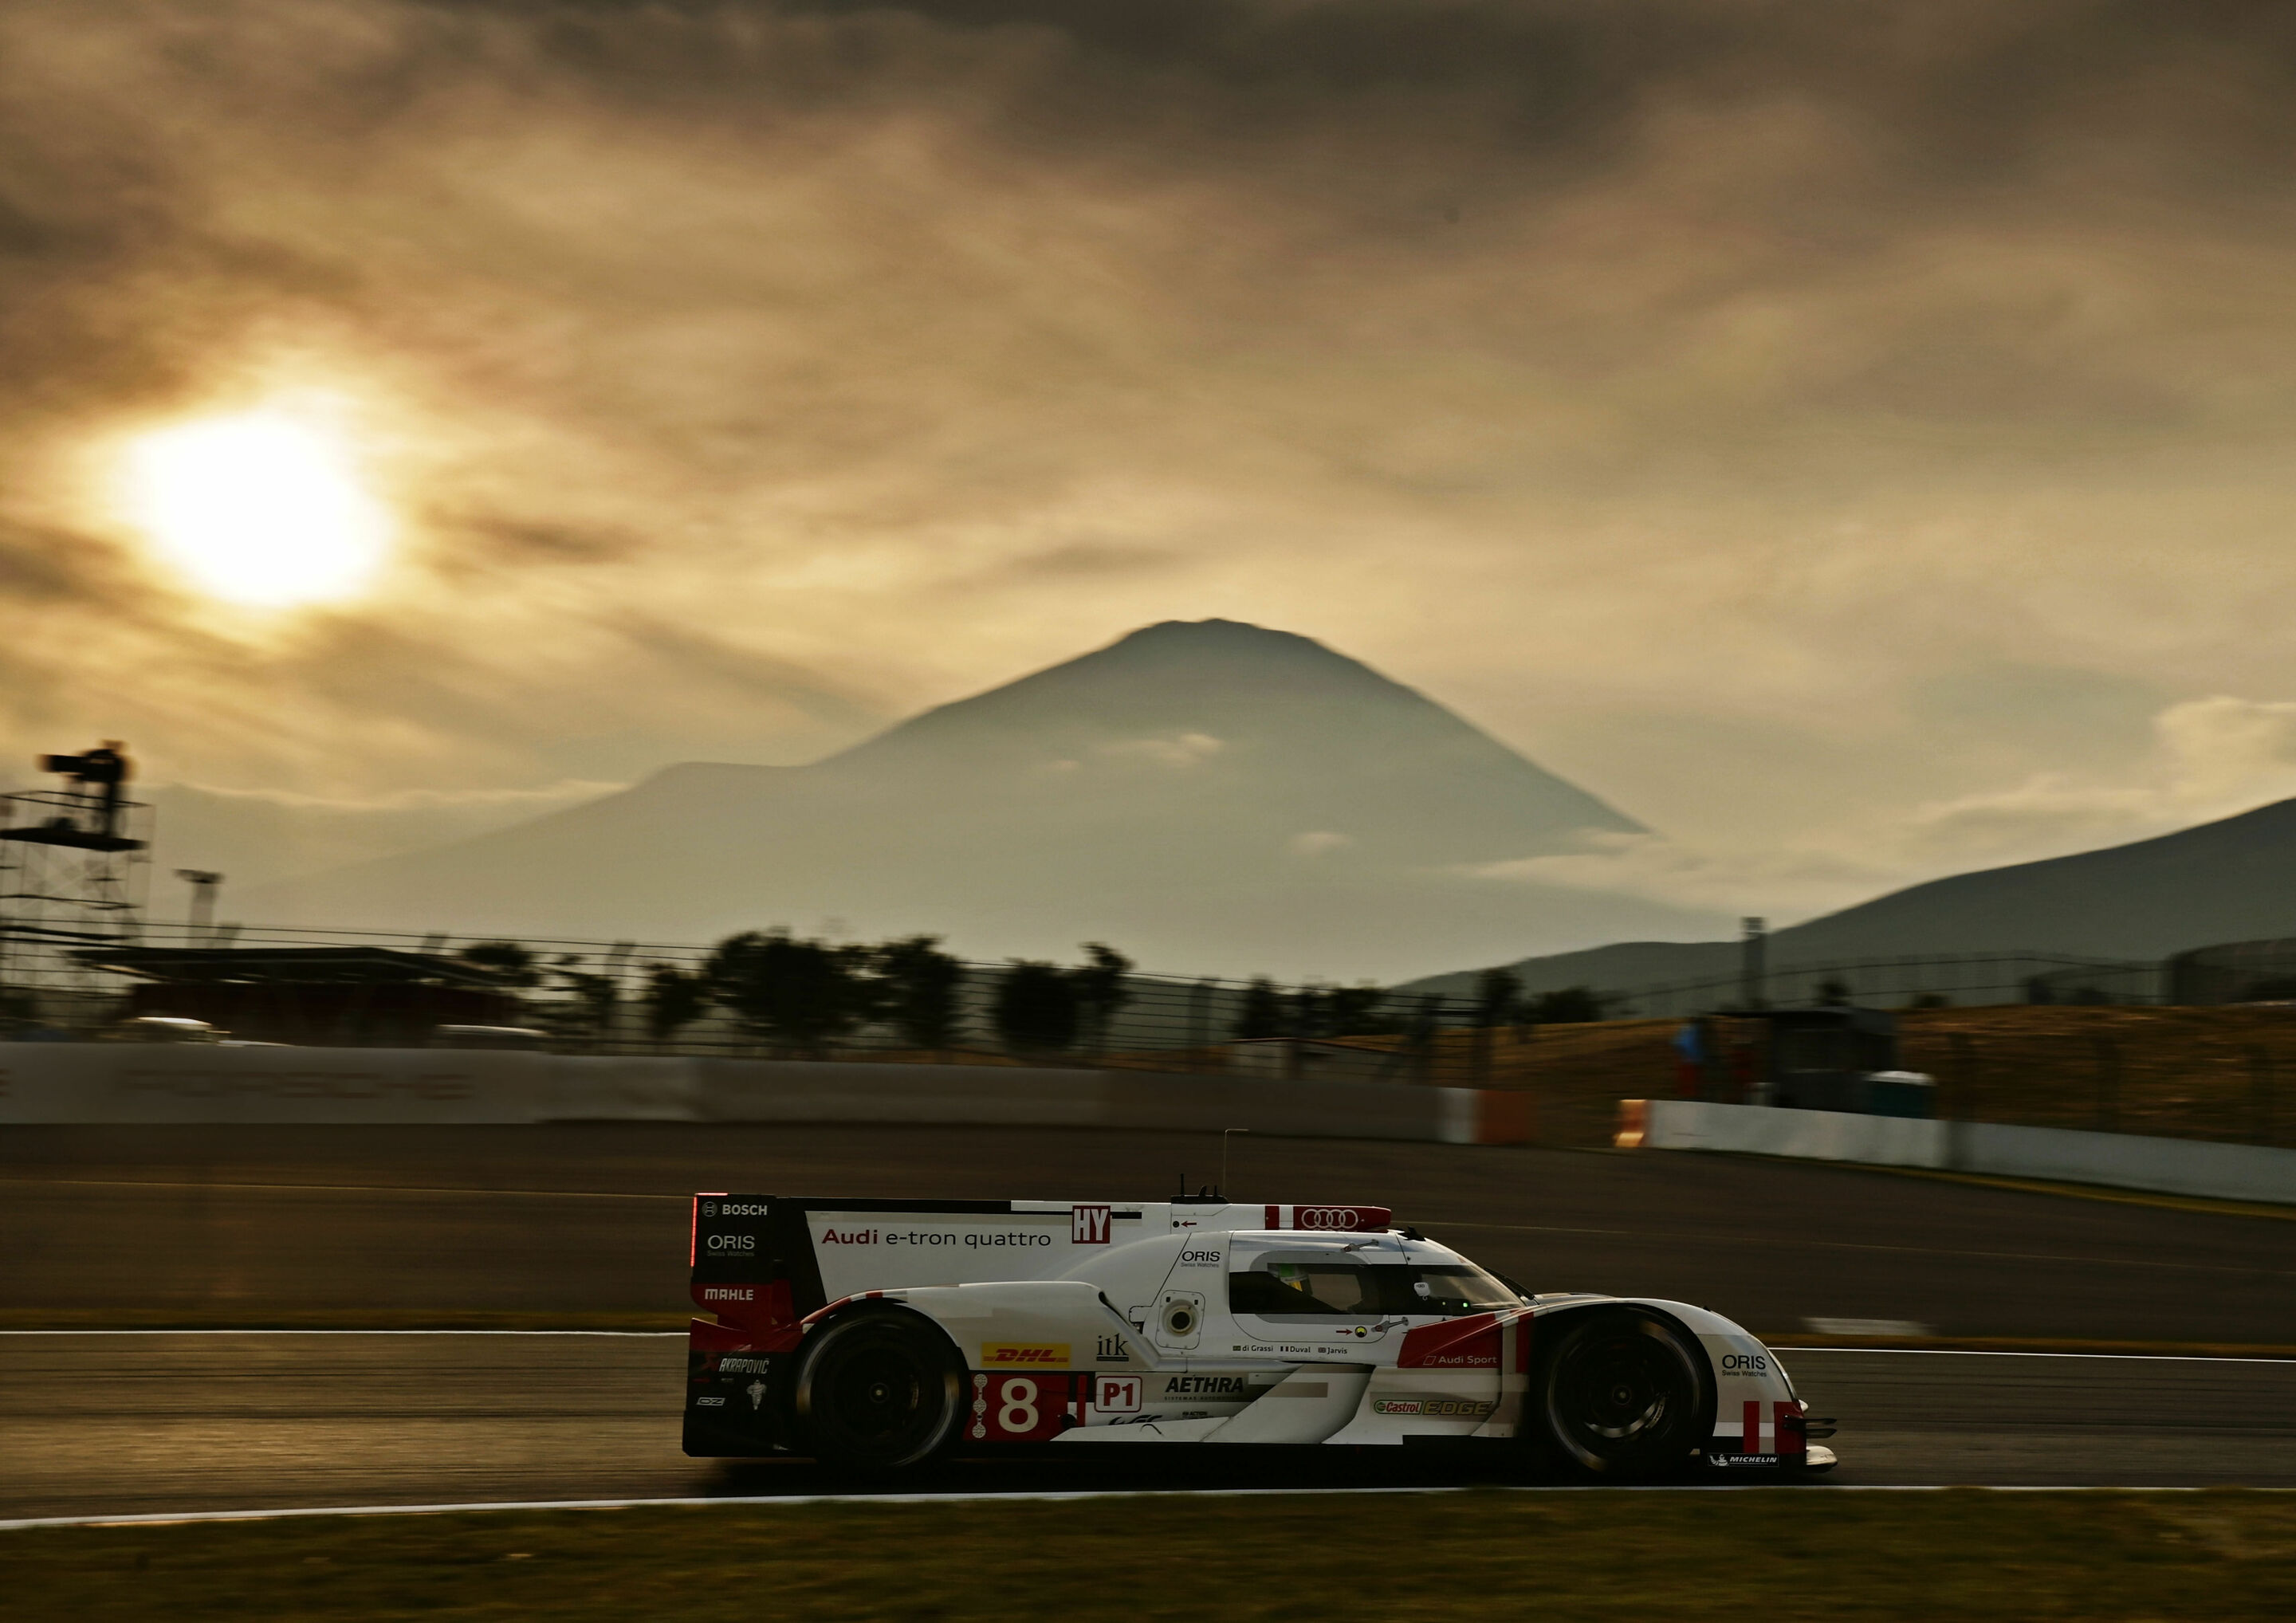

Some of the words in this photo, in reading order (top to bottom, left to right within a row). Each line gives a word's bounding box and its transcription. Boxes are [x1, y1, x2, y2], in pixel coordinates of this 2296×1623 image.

[721, 1204, 769, 1216] BOSCH
[1073, 1208, 1109, 1241] HY
[707, 1234, 756, 1250] ORIS
[822, 1228, 878, 1245] Audi
[886, 1230, 957, 1245] e-tron
[965, 1231, 1052, 1249] quattro
[1181, 1251, 1221, 1262] ORIS
[705, 1288, 754, 1300] MAHLE
[1096, 1333, 1129, 1356] itk
[994, 1348, 1056, 1362] DHL
[1466, 1356, 1497, 1366] Sport
[1722, 1354, 1766, 1370] ORIS
[1165, 1377, 1244, 1393] AETHRA
[698, 1397, 724, 1406] OZ
[1103, 1382, 1134, 1406] P1
[998, 1377, 1039, 1433] 8
[1386, 1401, 1421, 1413] Castrol
[1423, 1401, 1493, 1415] EDGE
